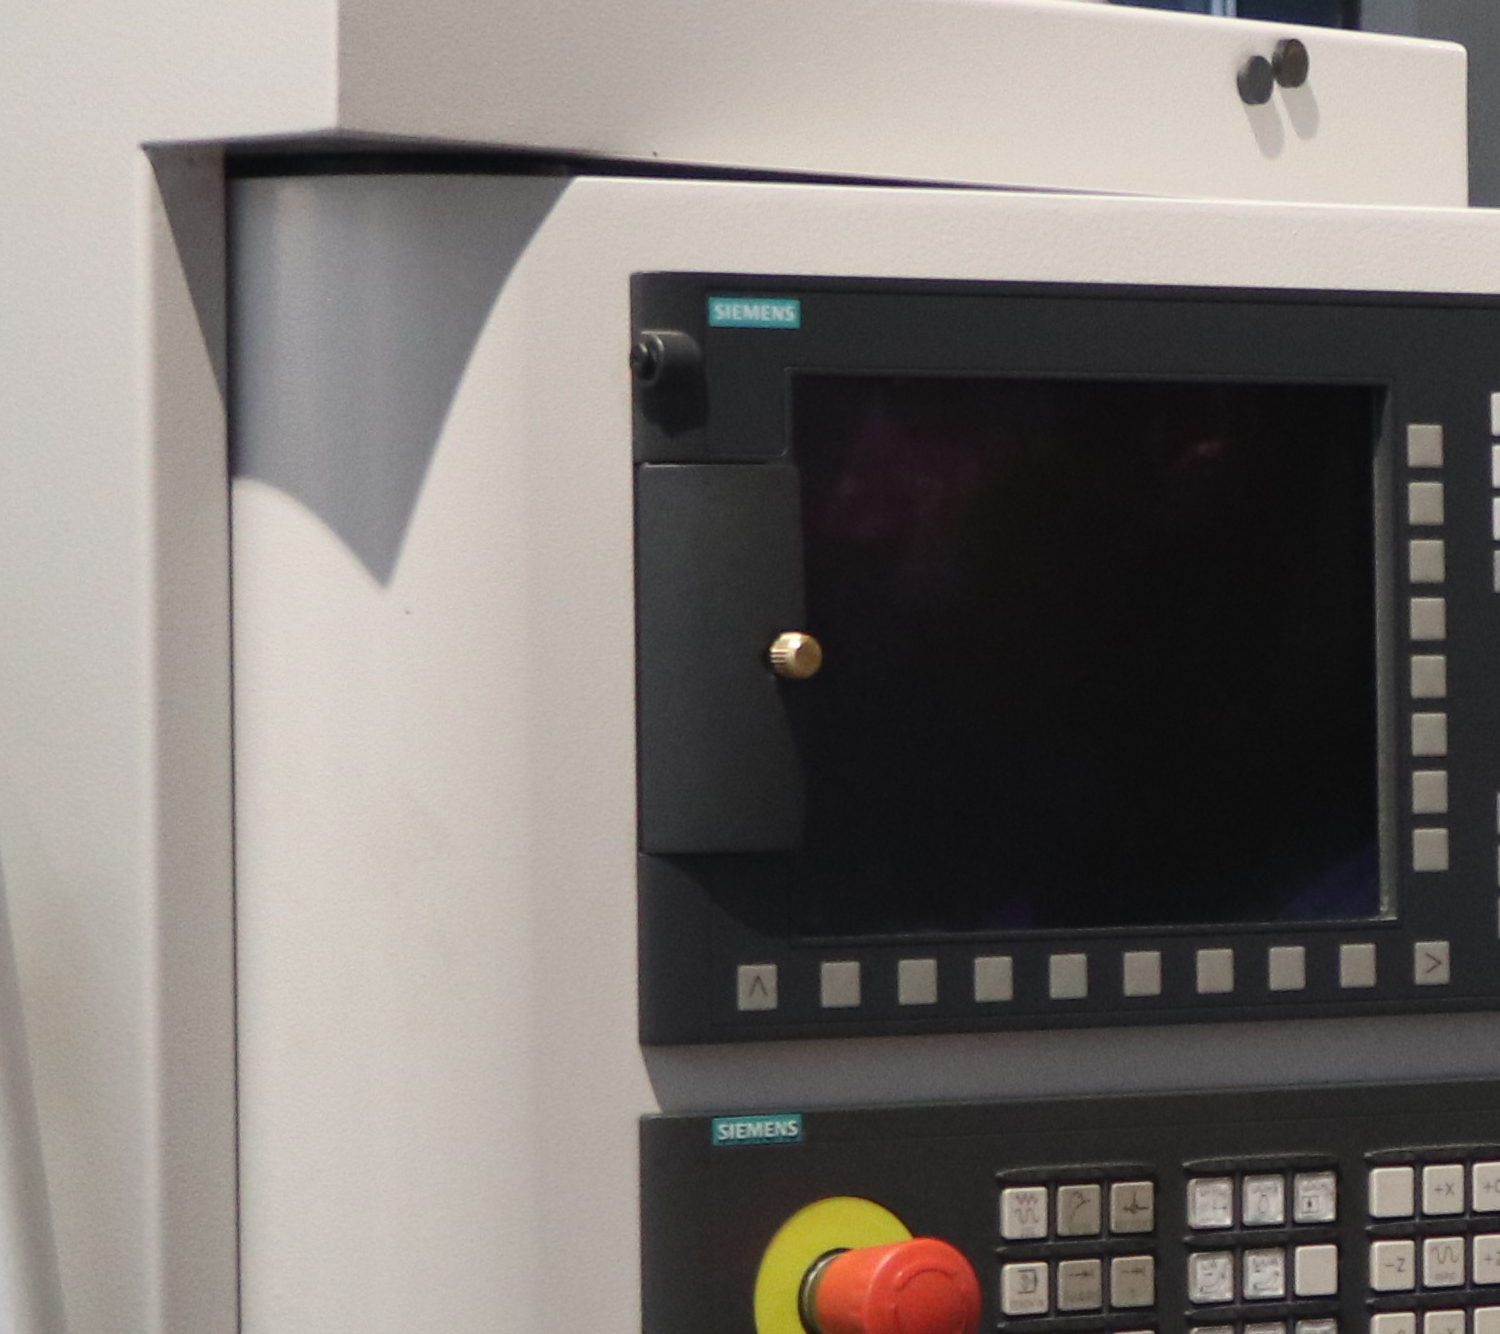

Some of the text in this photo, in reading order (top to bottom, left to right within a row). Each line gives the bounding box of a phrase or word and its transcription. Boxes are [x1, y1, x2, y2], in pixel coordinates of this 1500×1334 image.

[714, 303, 796, 322] SIEMENS
[717, 1120, 799, 1141] SIEMENS
[1434, 1182, 1455, 1196] +X
[1384, 1257, 1406, 1274] -Z
